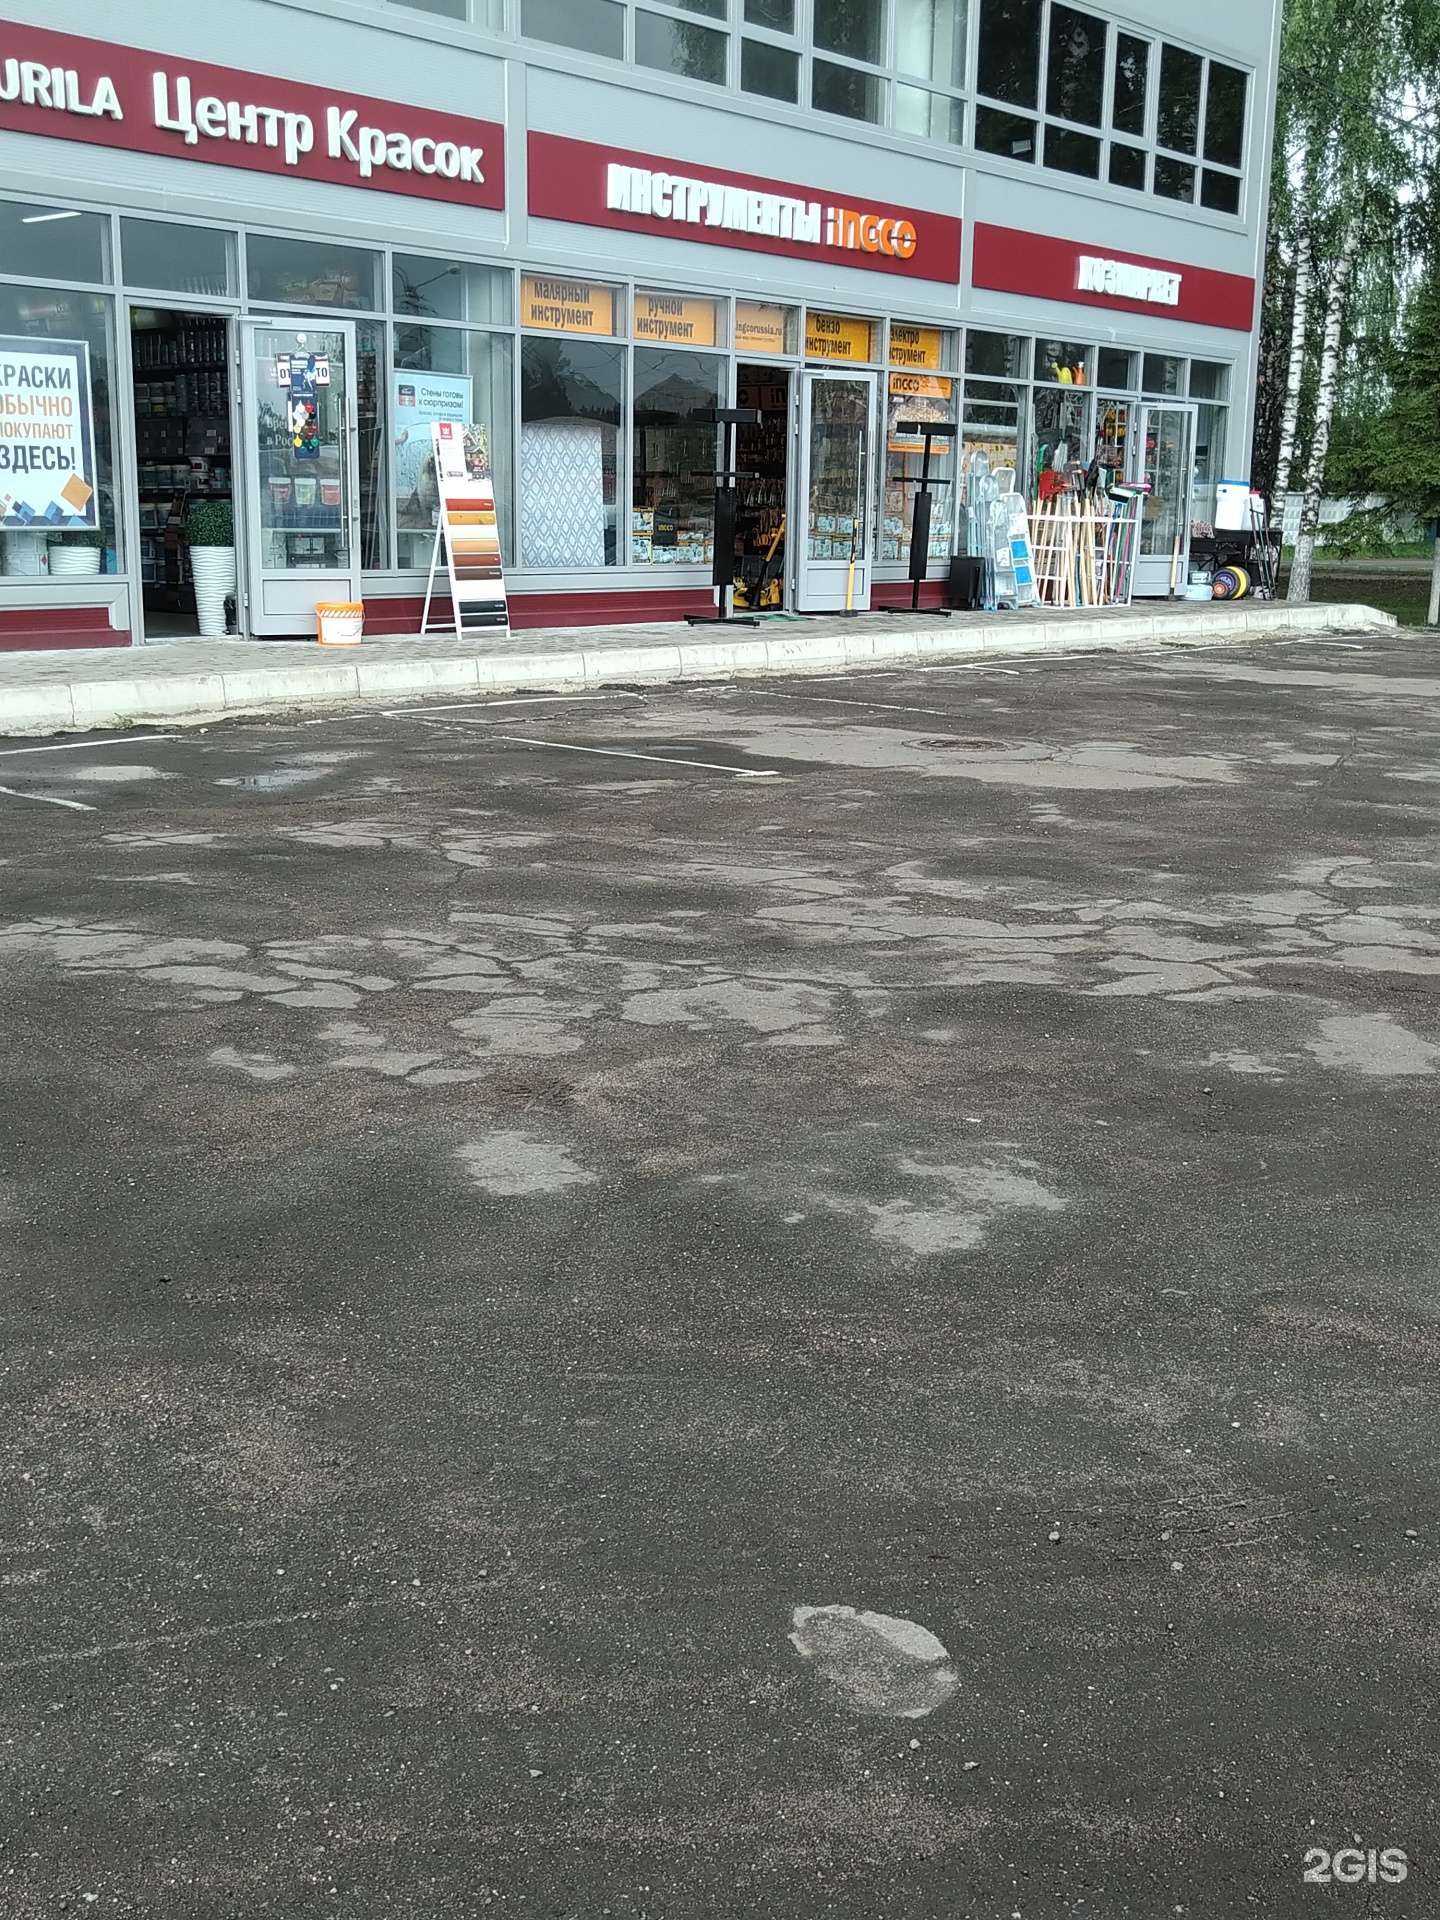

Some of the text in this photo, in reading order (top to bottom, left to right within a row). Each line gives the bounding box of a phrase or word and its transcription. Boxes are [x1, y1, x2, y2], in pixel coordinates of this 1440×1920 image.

[153, 72, 484, 184] Центр Красок
[607, 163, 821, 244] ИНСТРУМЕНТЫ
[531, 303, 593, 327] инструмент
[636, 316, 694, 339] инструмент
[816, 313, 840, 335] бензо
[0, 364, 71, 390] РАСКИ
[0, 421, 73, 440] ОКУПАЮТ
[0, 444, 76, 474] ЗДЕСЬ!
